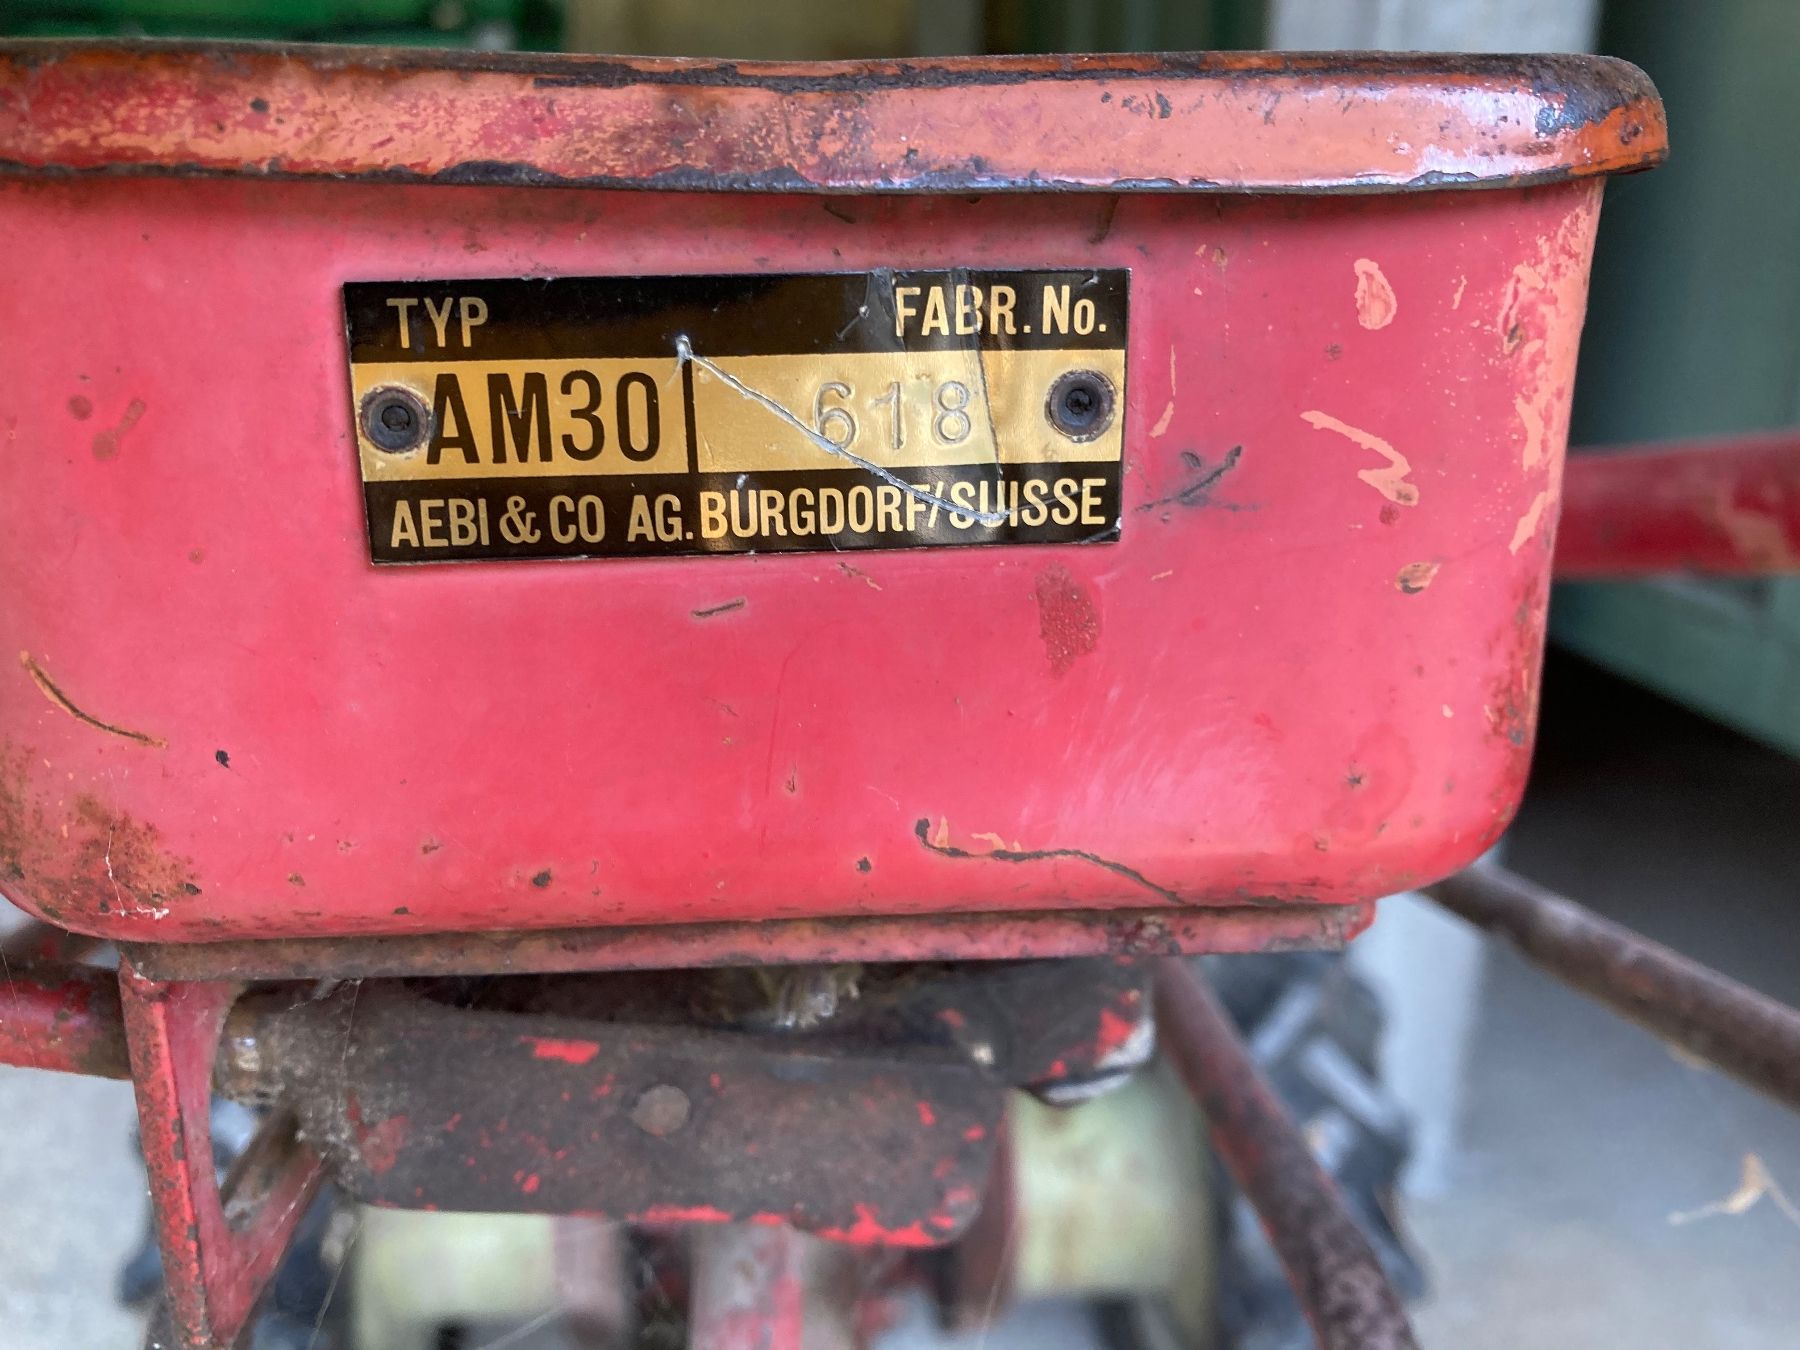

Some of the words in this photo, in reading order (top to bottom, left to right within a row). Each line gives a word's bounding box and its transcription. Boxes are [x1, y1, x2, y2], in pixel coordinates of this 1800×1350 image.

[387, 296, 488, 349] TYP
[895, 284, 1032, 337] FABR.
[1042, 284, 1108, 336] No.
[426, 369, 661, 465] AM30
[812, 379, 972, 451] 618
[390, 497, 490, 548] AEBI
[499, 494, 542, 545] &
[549, 494, 606, 545] CO
[627, 493, 694, 543] AG.
